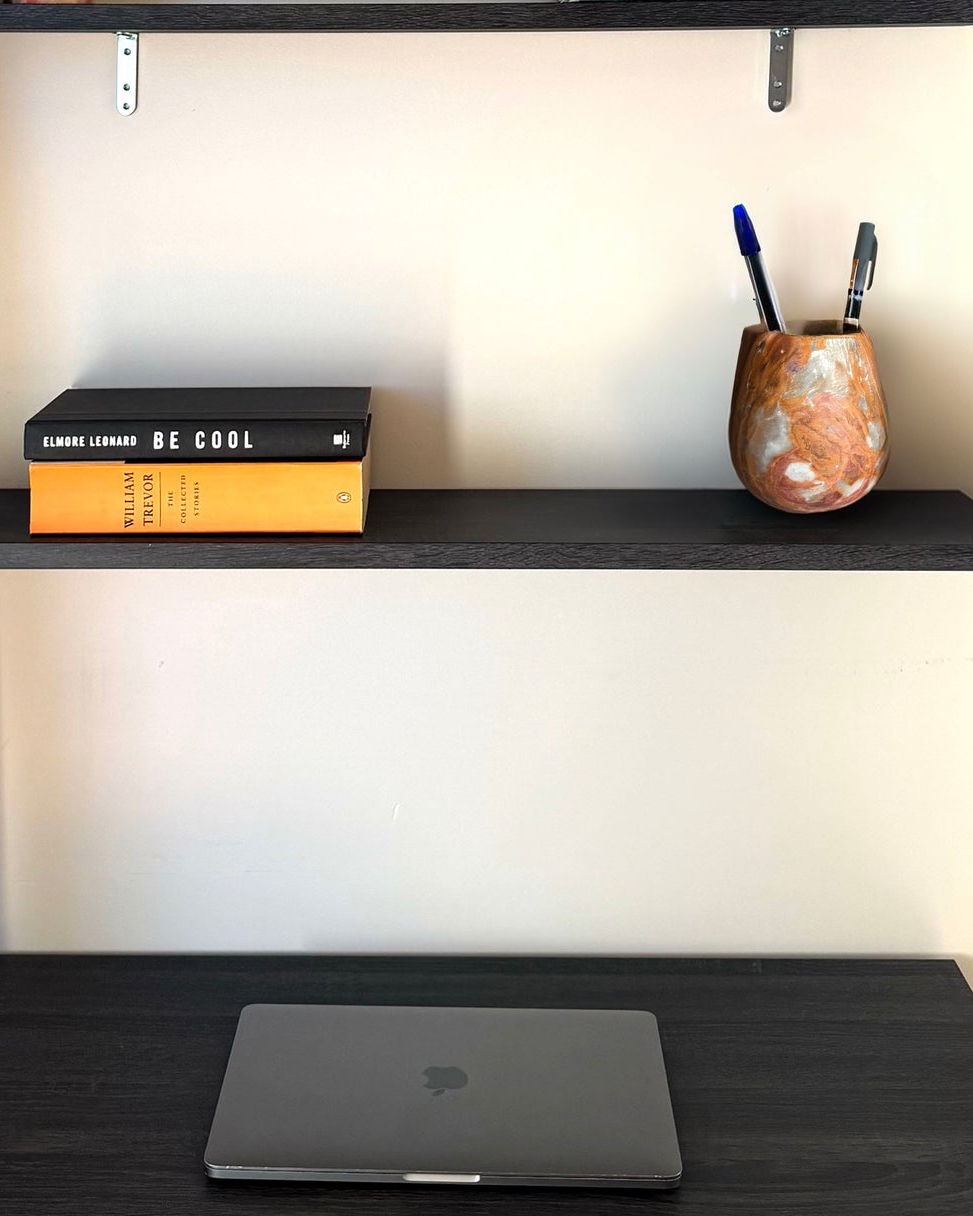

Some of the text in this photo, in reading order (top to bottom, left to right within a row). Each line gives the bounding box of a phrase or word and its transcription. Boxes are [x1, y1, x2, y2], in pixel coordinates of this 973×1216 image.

[43, 435, 137, 448] ELMORE LEONARD
[153, 430, 253, 450] BE COOL
[123, 471, 135, 529] WILLIAM
[142, 473, 154, 527] TREVOR
